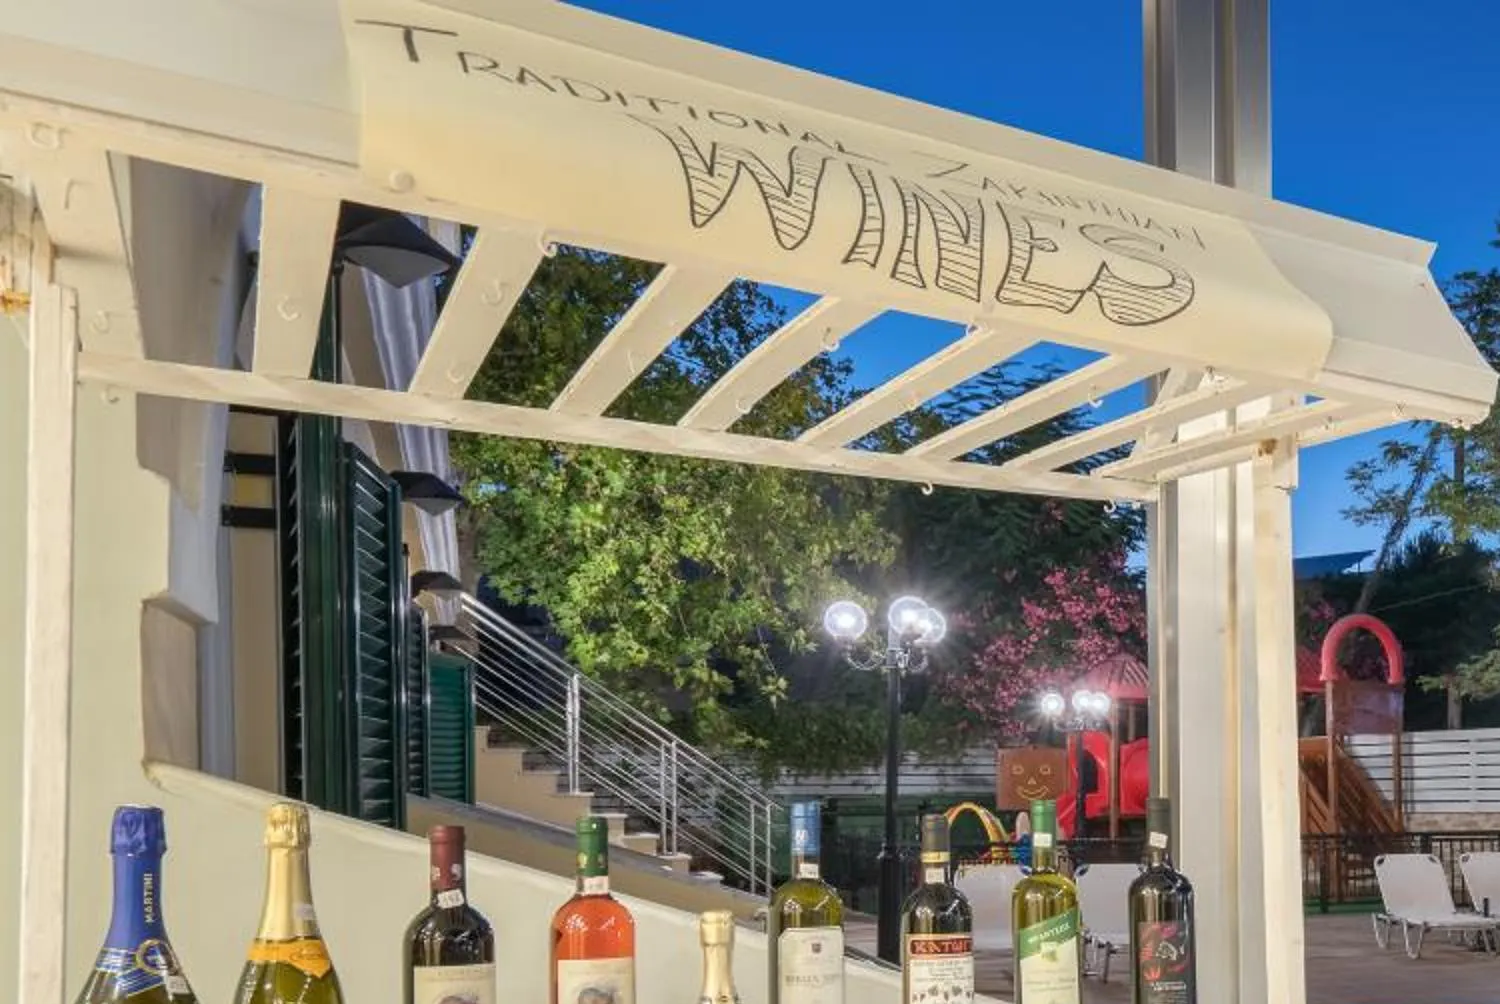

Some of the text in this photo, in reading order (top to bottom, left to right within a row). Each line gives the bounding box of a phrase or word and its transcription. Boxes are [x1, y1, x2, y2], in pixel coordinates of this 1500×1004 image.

[353, 19, 888, 166] TRADITIONAL
[622, 110, 1194, 326] WINES
[142, 872, 154, 924] MARTINI
